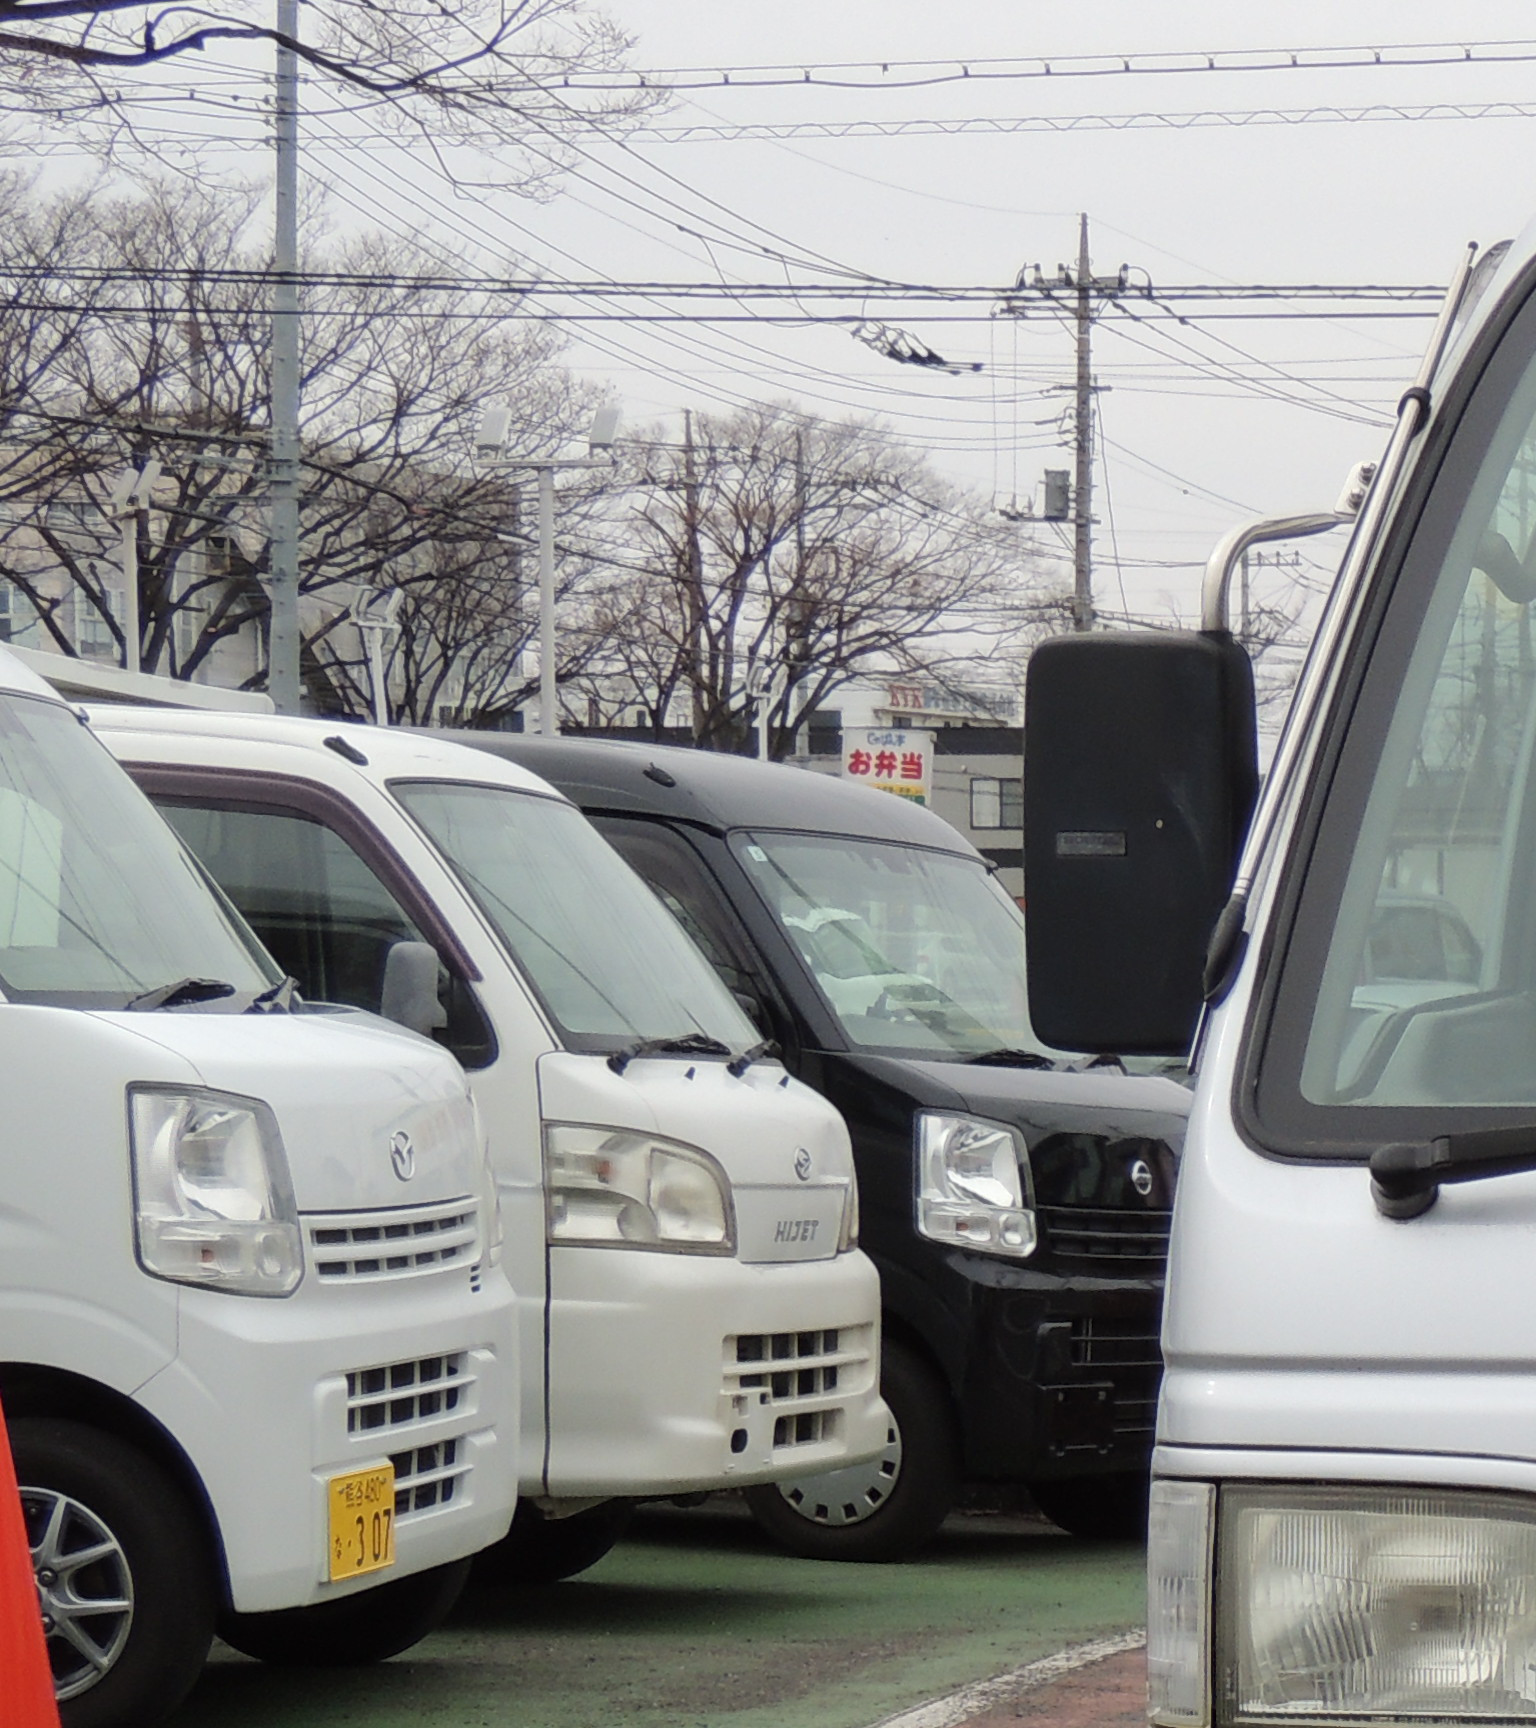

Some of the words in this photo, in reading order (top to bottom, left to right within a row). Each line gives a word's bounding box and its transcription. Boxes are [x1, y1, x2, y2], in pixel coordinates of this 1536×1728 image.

[848, 749, 924, 780] お弁当
[774, 1219, 819, 1242] HIJET
